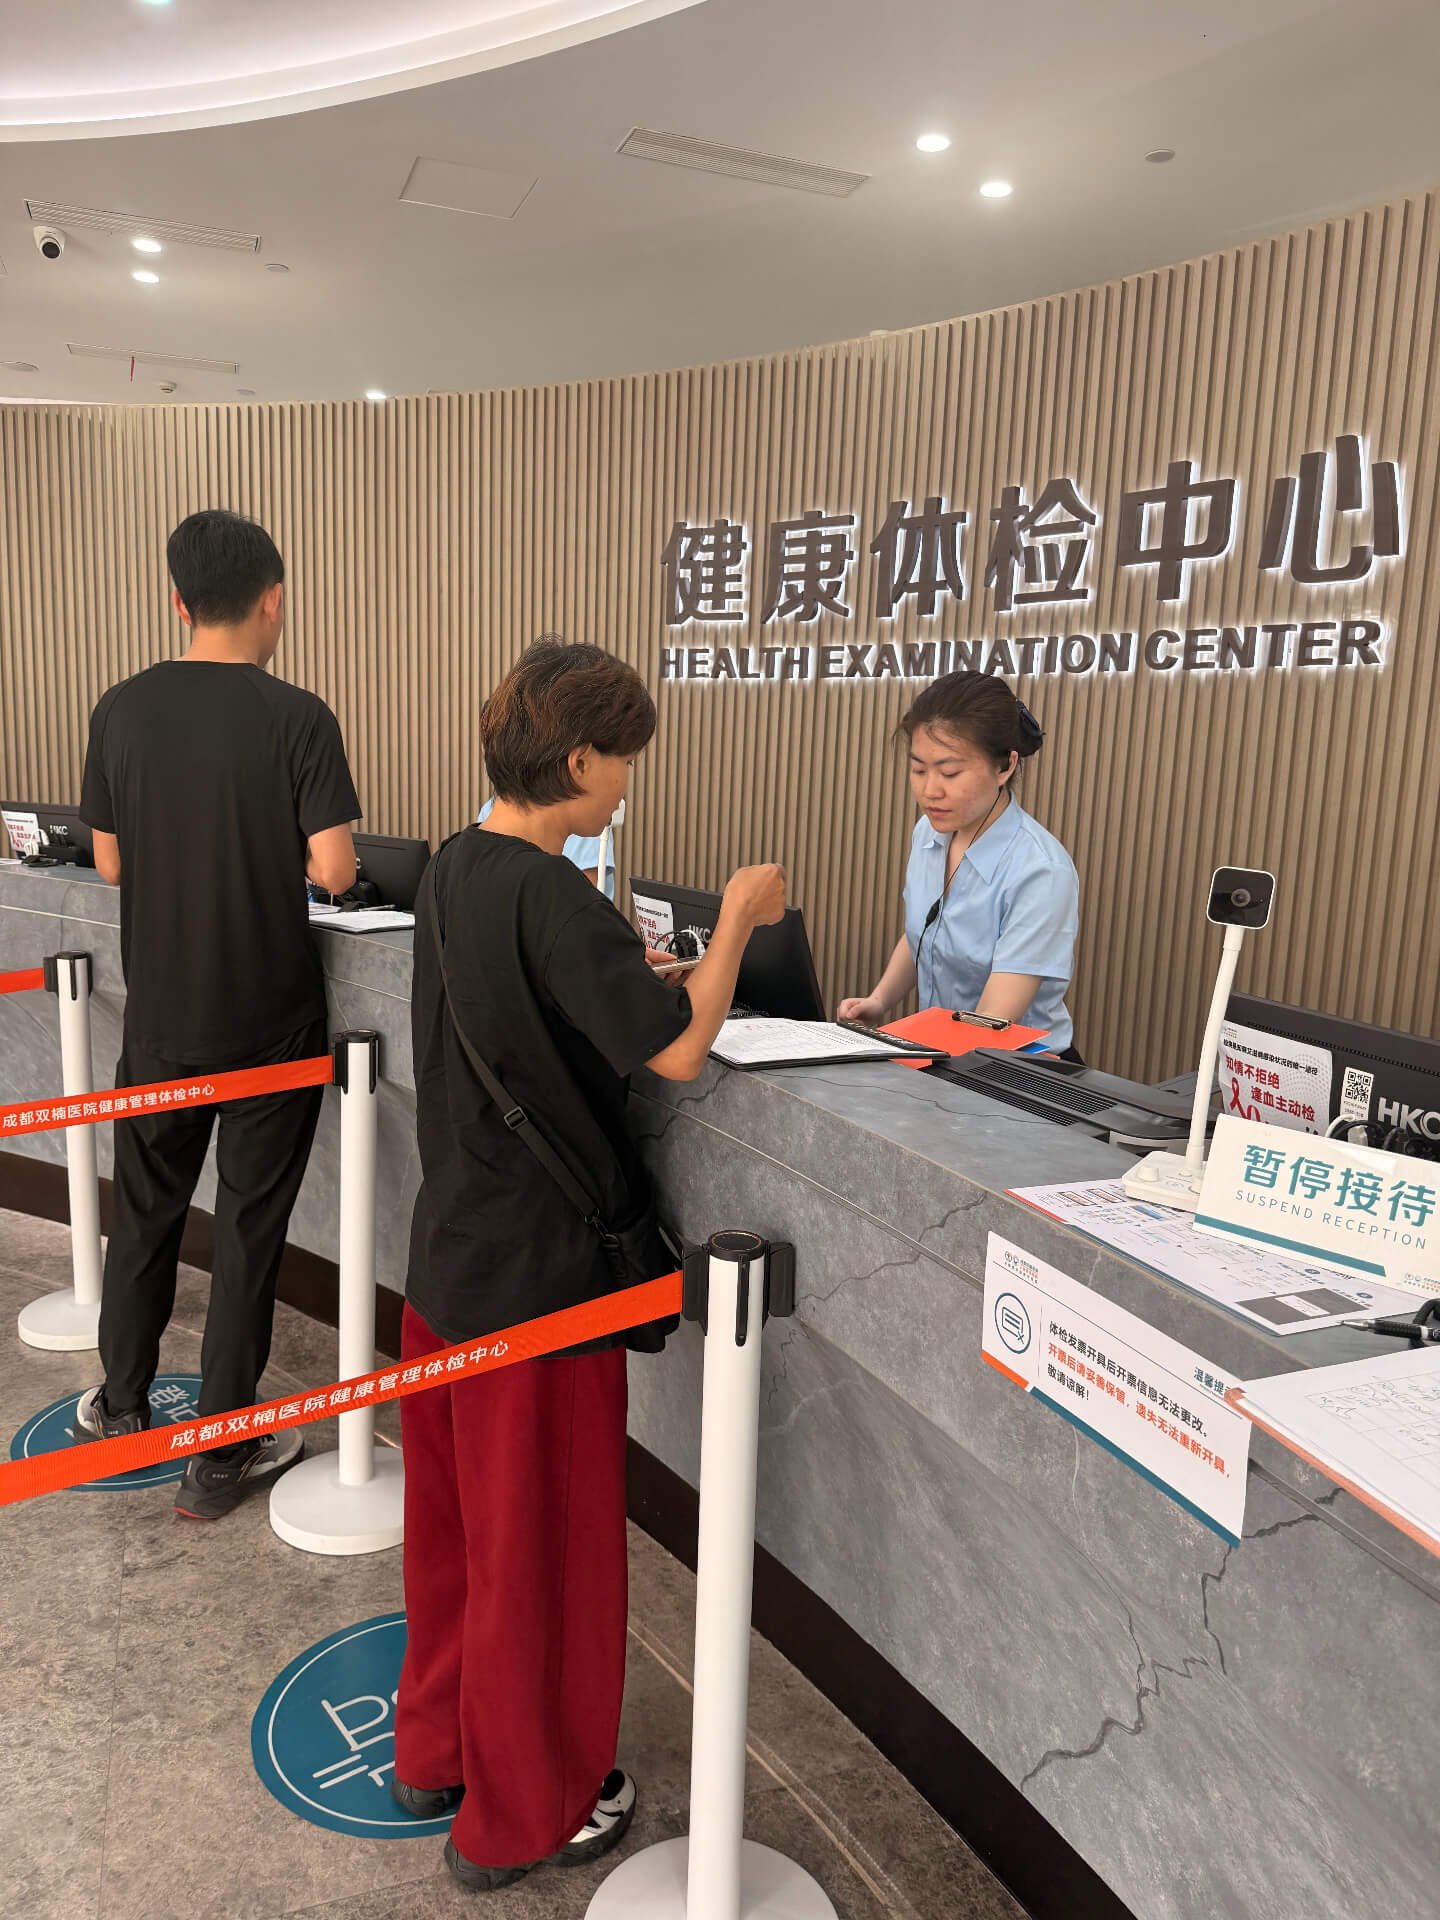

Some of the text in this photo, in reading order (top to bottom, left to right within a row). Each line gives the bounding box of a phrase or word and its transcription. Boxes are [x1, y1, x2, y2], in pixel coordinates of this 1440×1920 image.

[661, 435, 1401, 625] 健康体检中心
[661, 619, 1385, 679] HEALTH EXAMINATION CENTER
[1226, 1056, 1280, 1090] 知情不拒绝
[2, 1083, 216, 1129] 成都双楠医院健康管理体检中心
[1243, 1144, 1436, 1228] 暂停接待
[1235, 1189, 1314, 1219] SUSPEND
[1322, 1212, 1427, 1250] RECEPTION
[170, 1340, 510, 1450] 成都双楠医院健康管理体检中心
